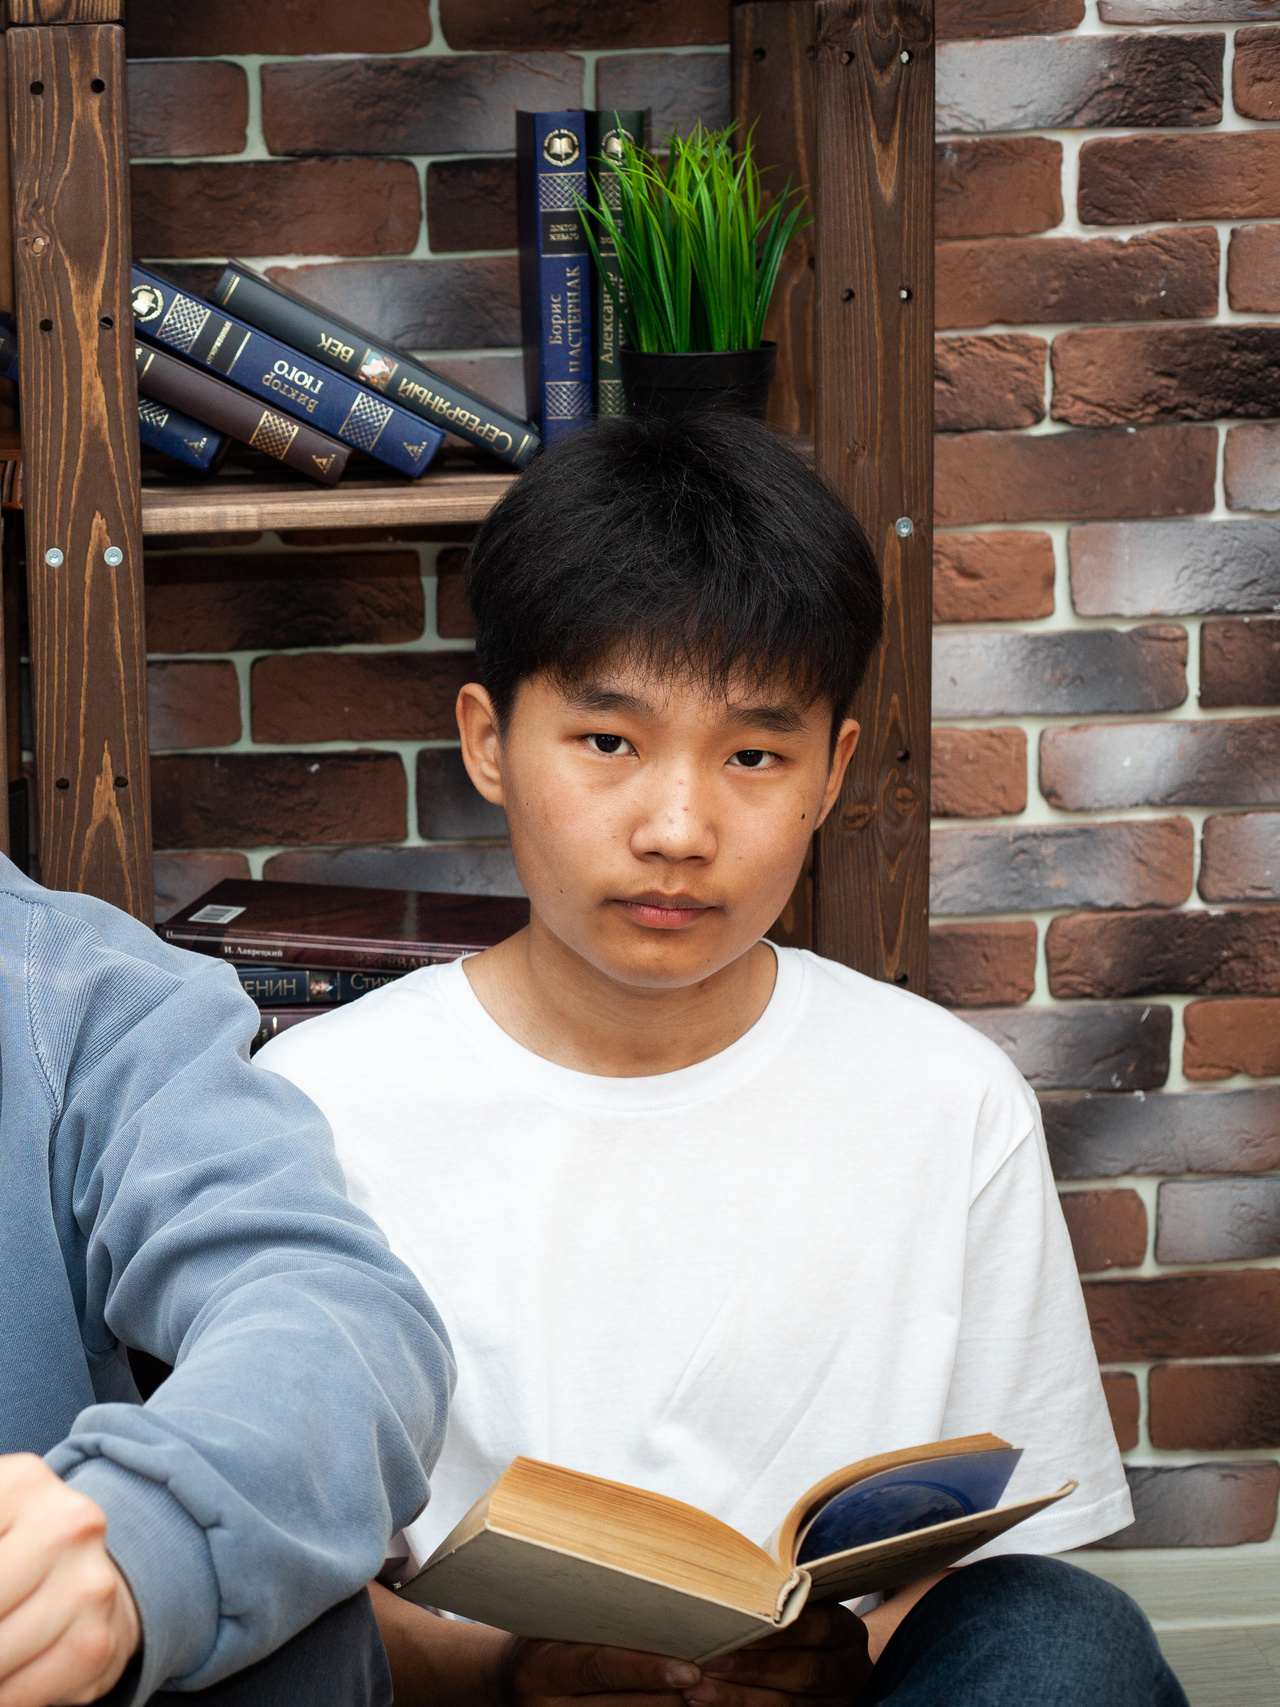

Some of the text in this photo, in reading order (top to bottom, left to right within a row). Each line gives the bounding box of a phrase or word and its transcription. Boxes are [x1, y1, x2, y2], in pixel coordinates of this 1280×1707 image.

[549, 293, 566, 345] Борис
[566, 265, 583, 373] ПАСТЕРНАК
[316, 332, 355, 363] ВЕК
[261, 372, 319, 414] Виктор
[273, 359, 324, 394] ГЮГО
[240, 978, 297, 998] ЕНИН
